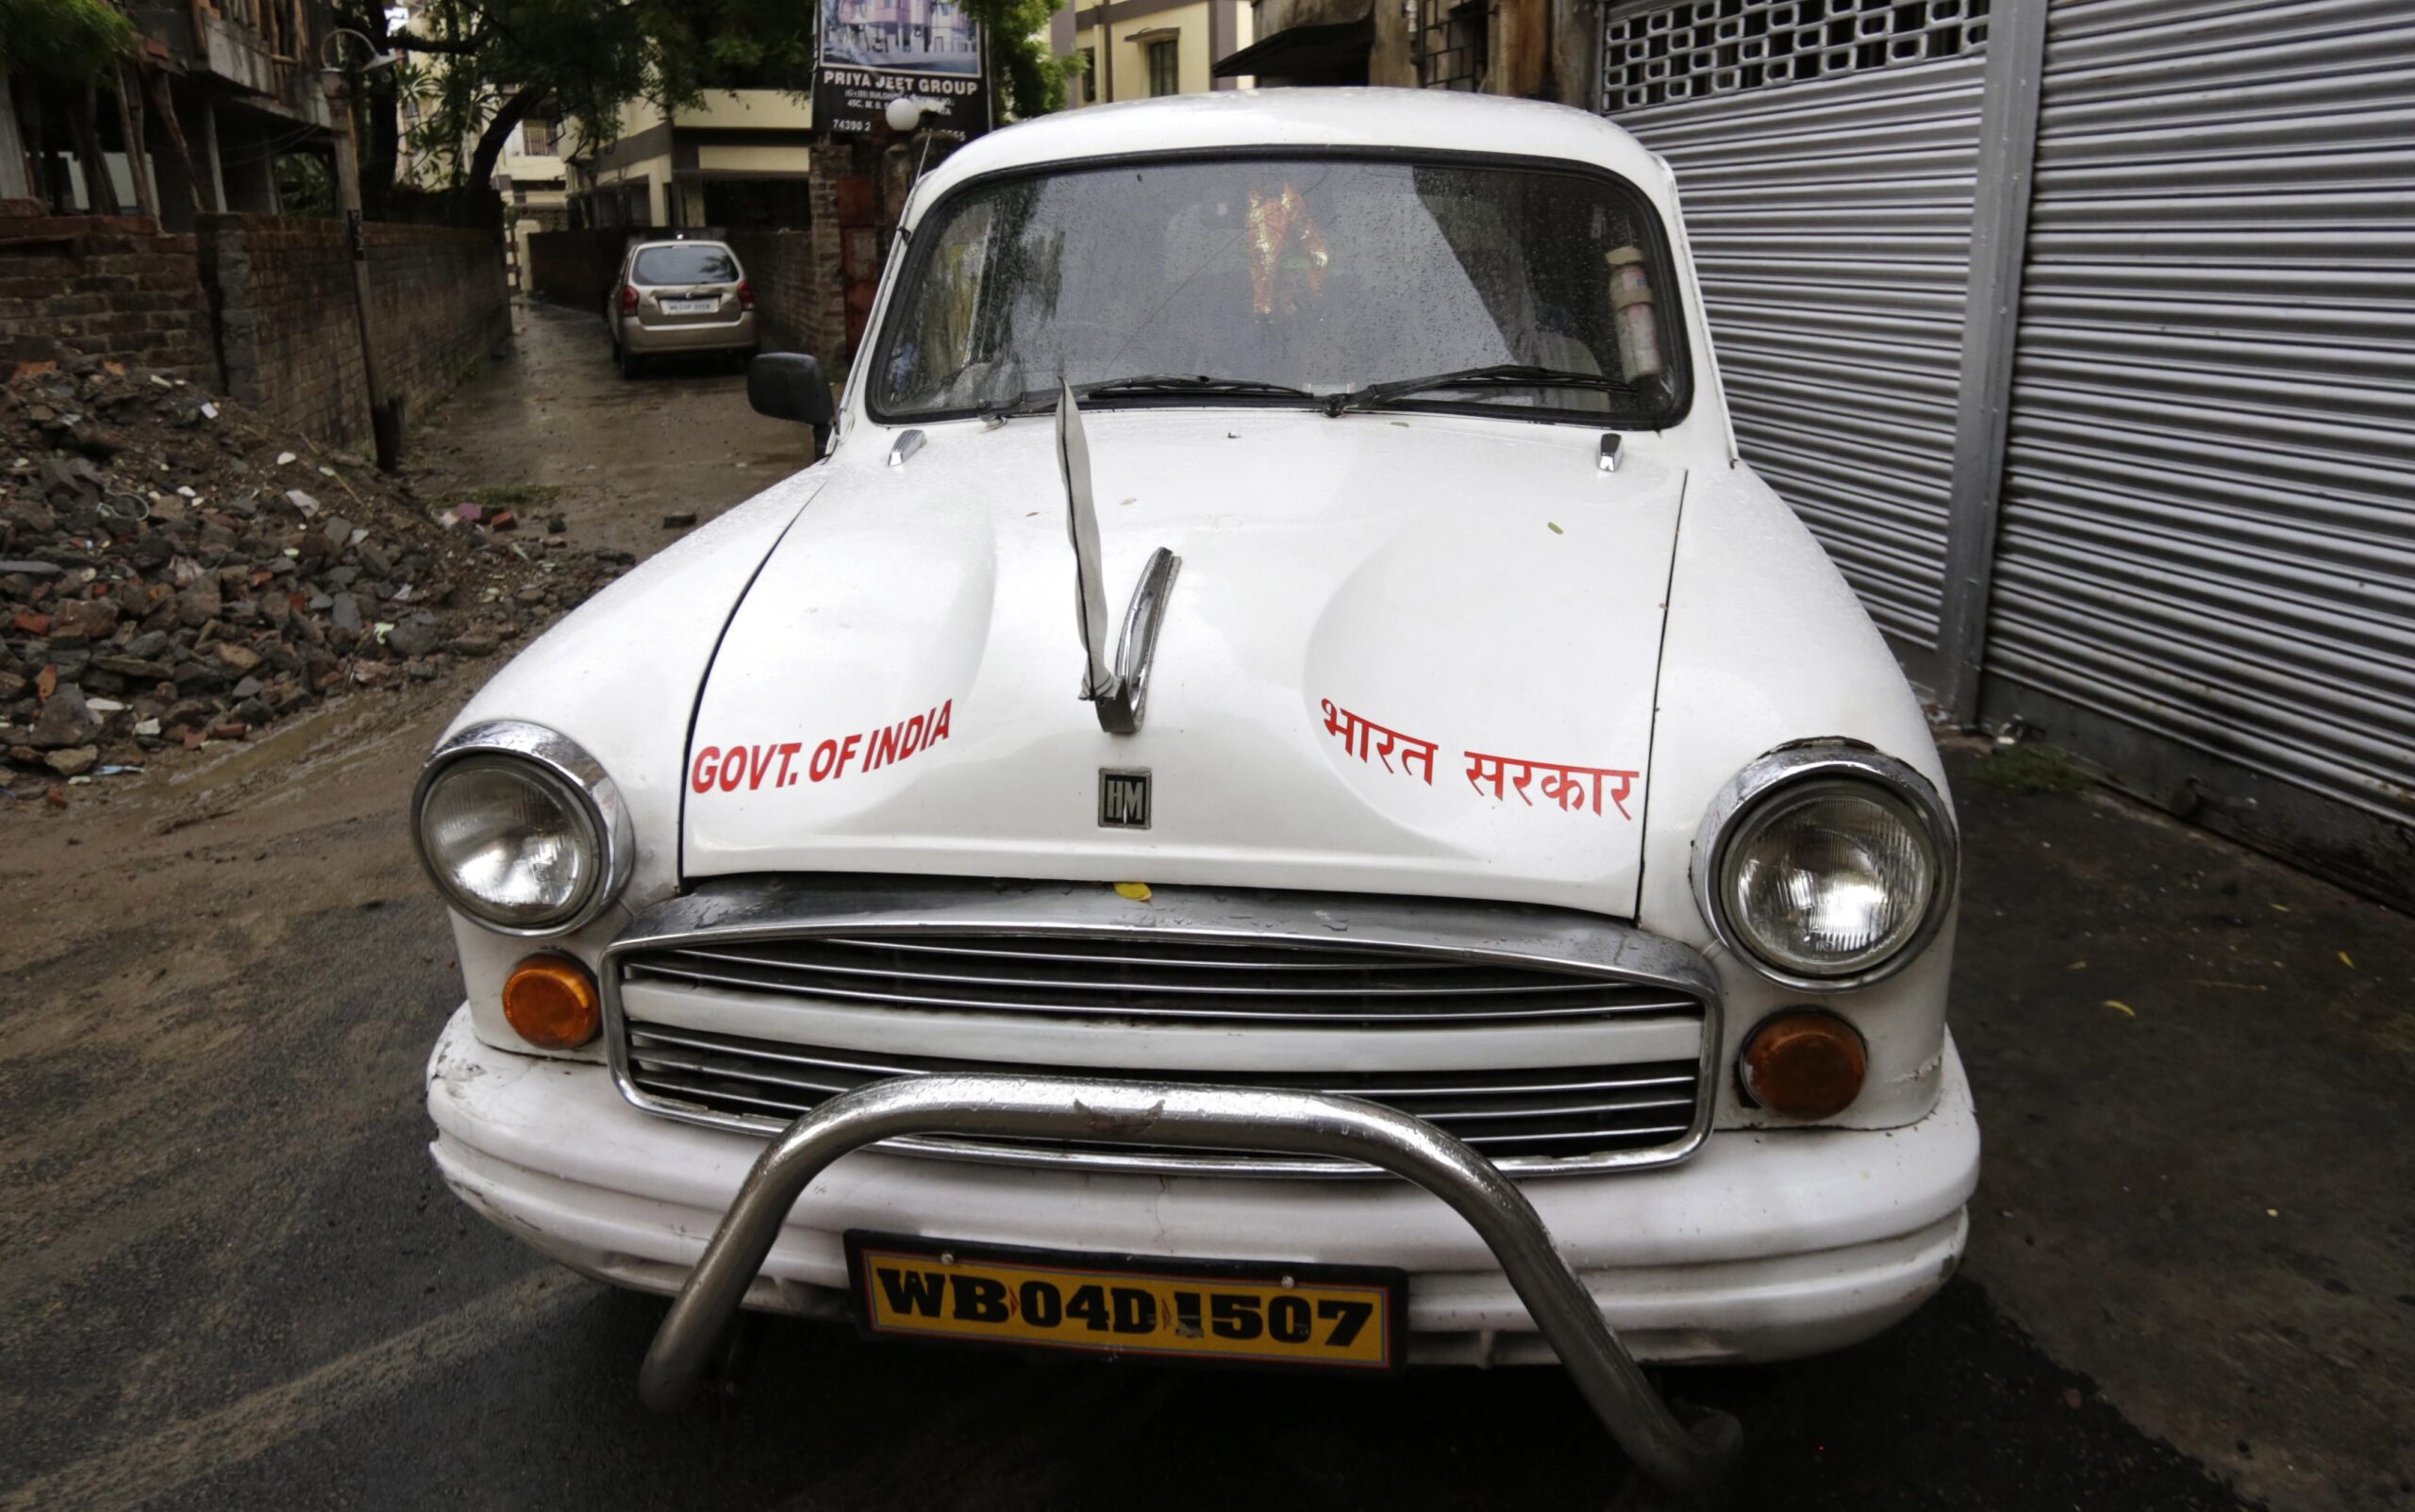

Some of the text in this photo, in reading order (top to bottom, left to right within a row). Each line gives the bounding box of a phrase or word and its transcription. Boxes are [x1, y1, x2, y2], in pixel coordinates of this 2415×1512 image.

[824, 71, 978, 95] PRIYA JEET GROUP
[691, 698, 952, 793] GOVT. OF INDIA
[1321, 698, 1640, 821] भारत सरकार
[1106, 780, 1144, 821] HM
